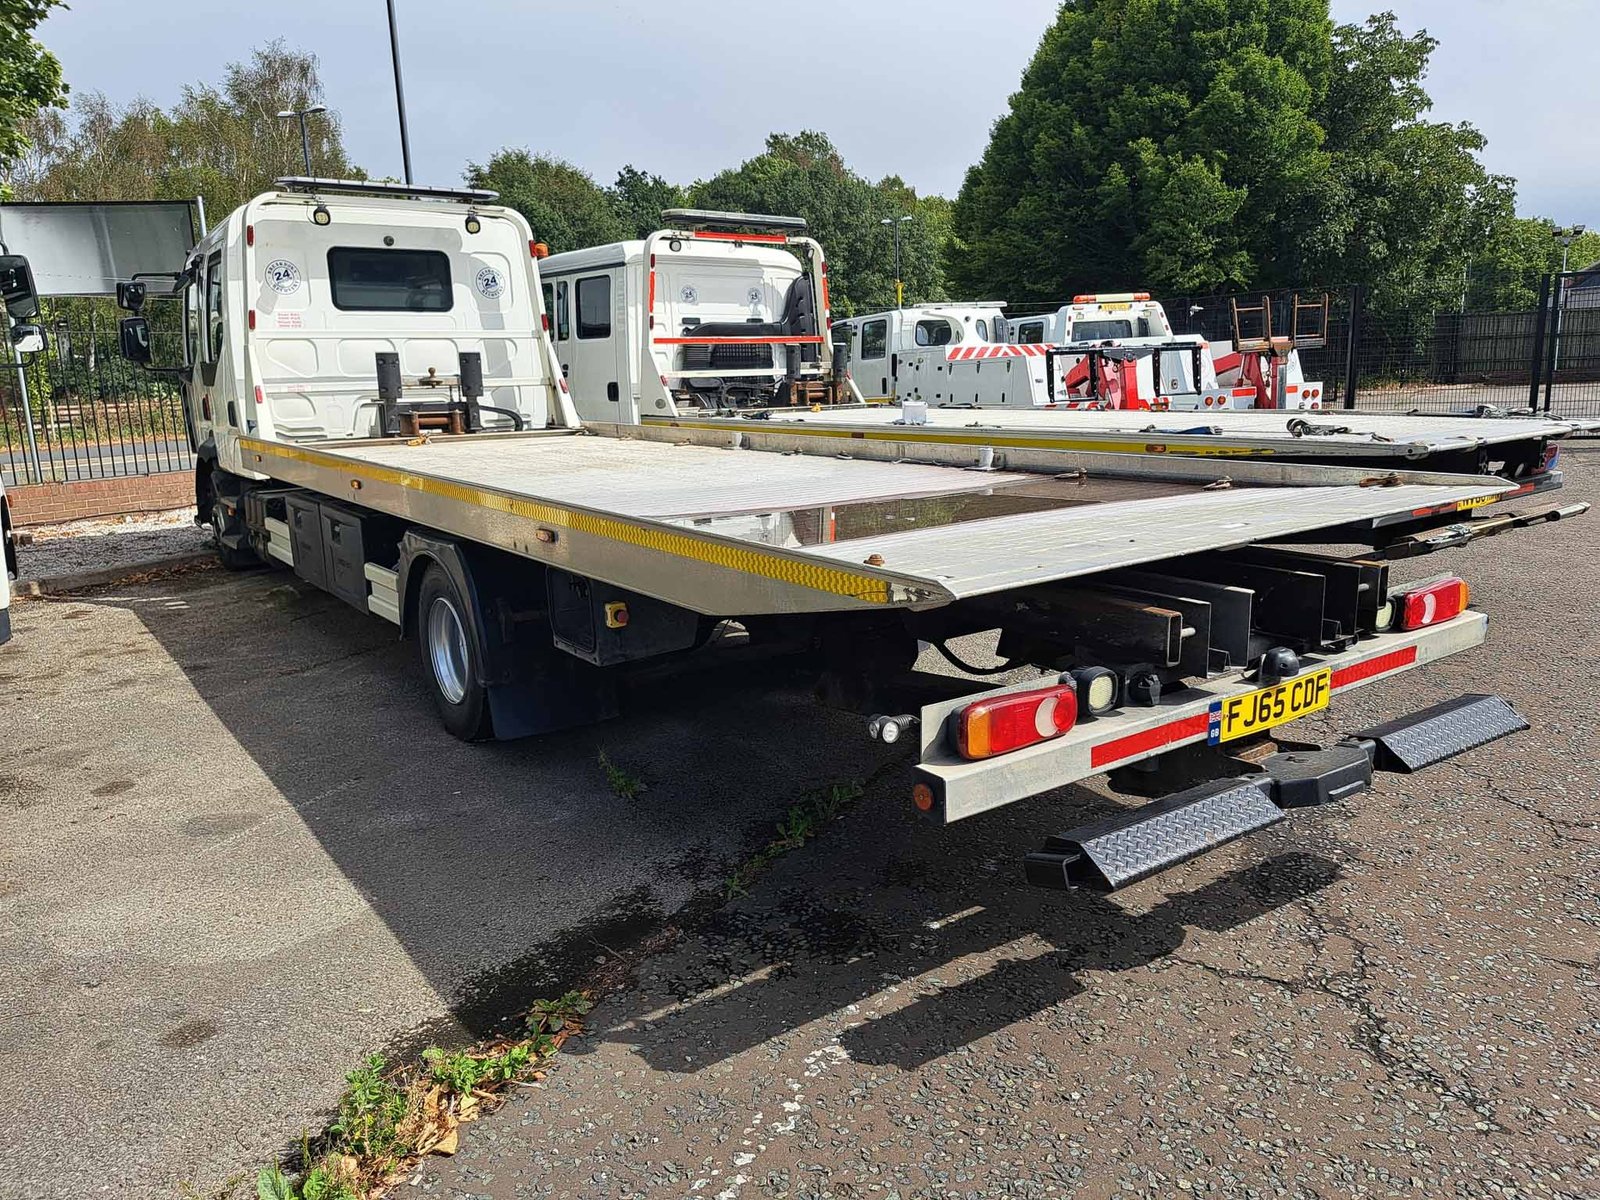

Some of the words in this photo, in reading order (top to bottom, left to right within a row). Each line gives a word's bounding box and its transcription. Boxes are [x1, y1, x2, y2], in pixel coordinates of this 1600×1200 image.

[274, 269, 290, 281] 24
[483, 275, 497, 287] 24
[1227, 686, 1287, 733] FJ65
[1290, 673, 1328, 712] CDF
[1210, 728, 1220, 738] GB
